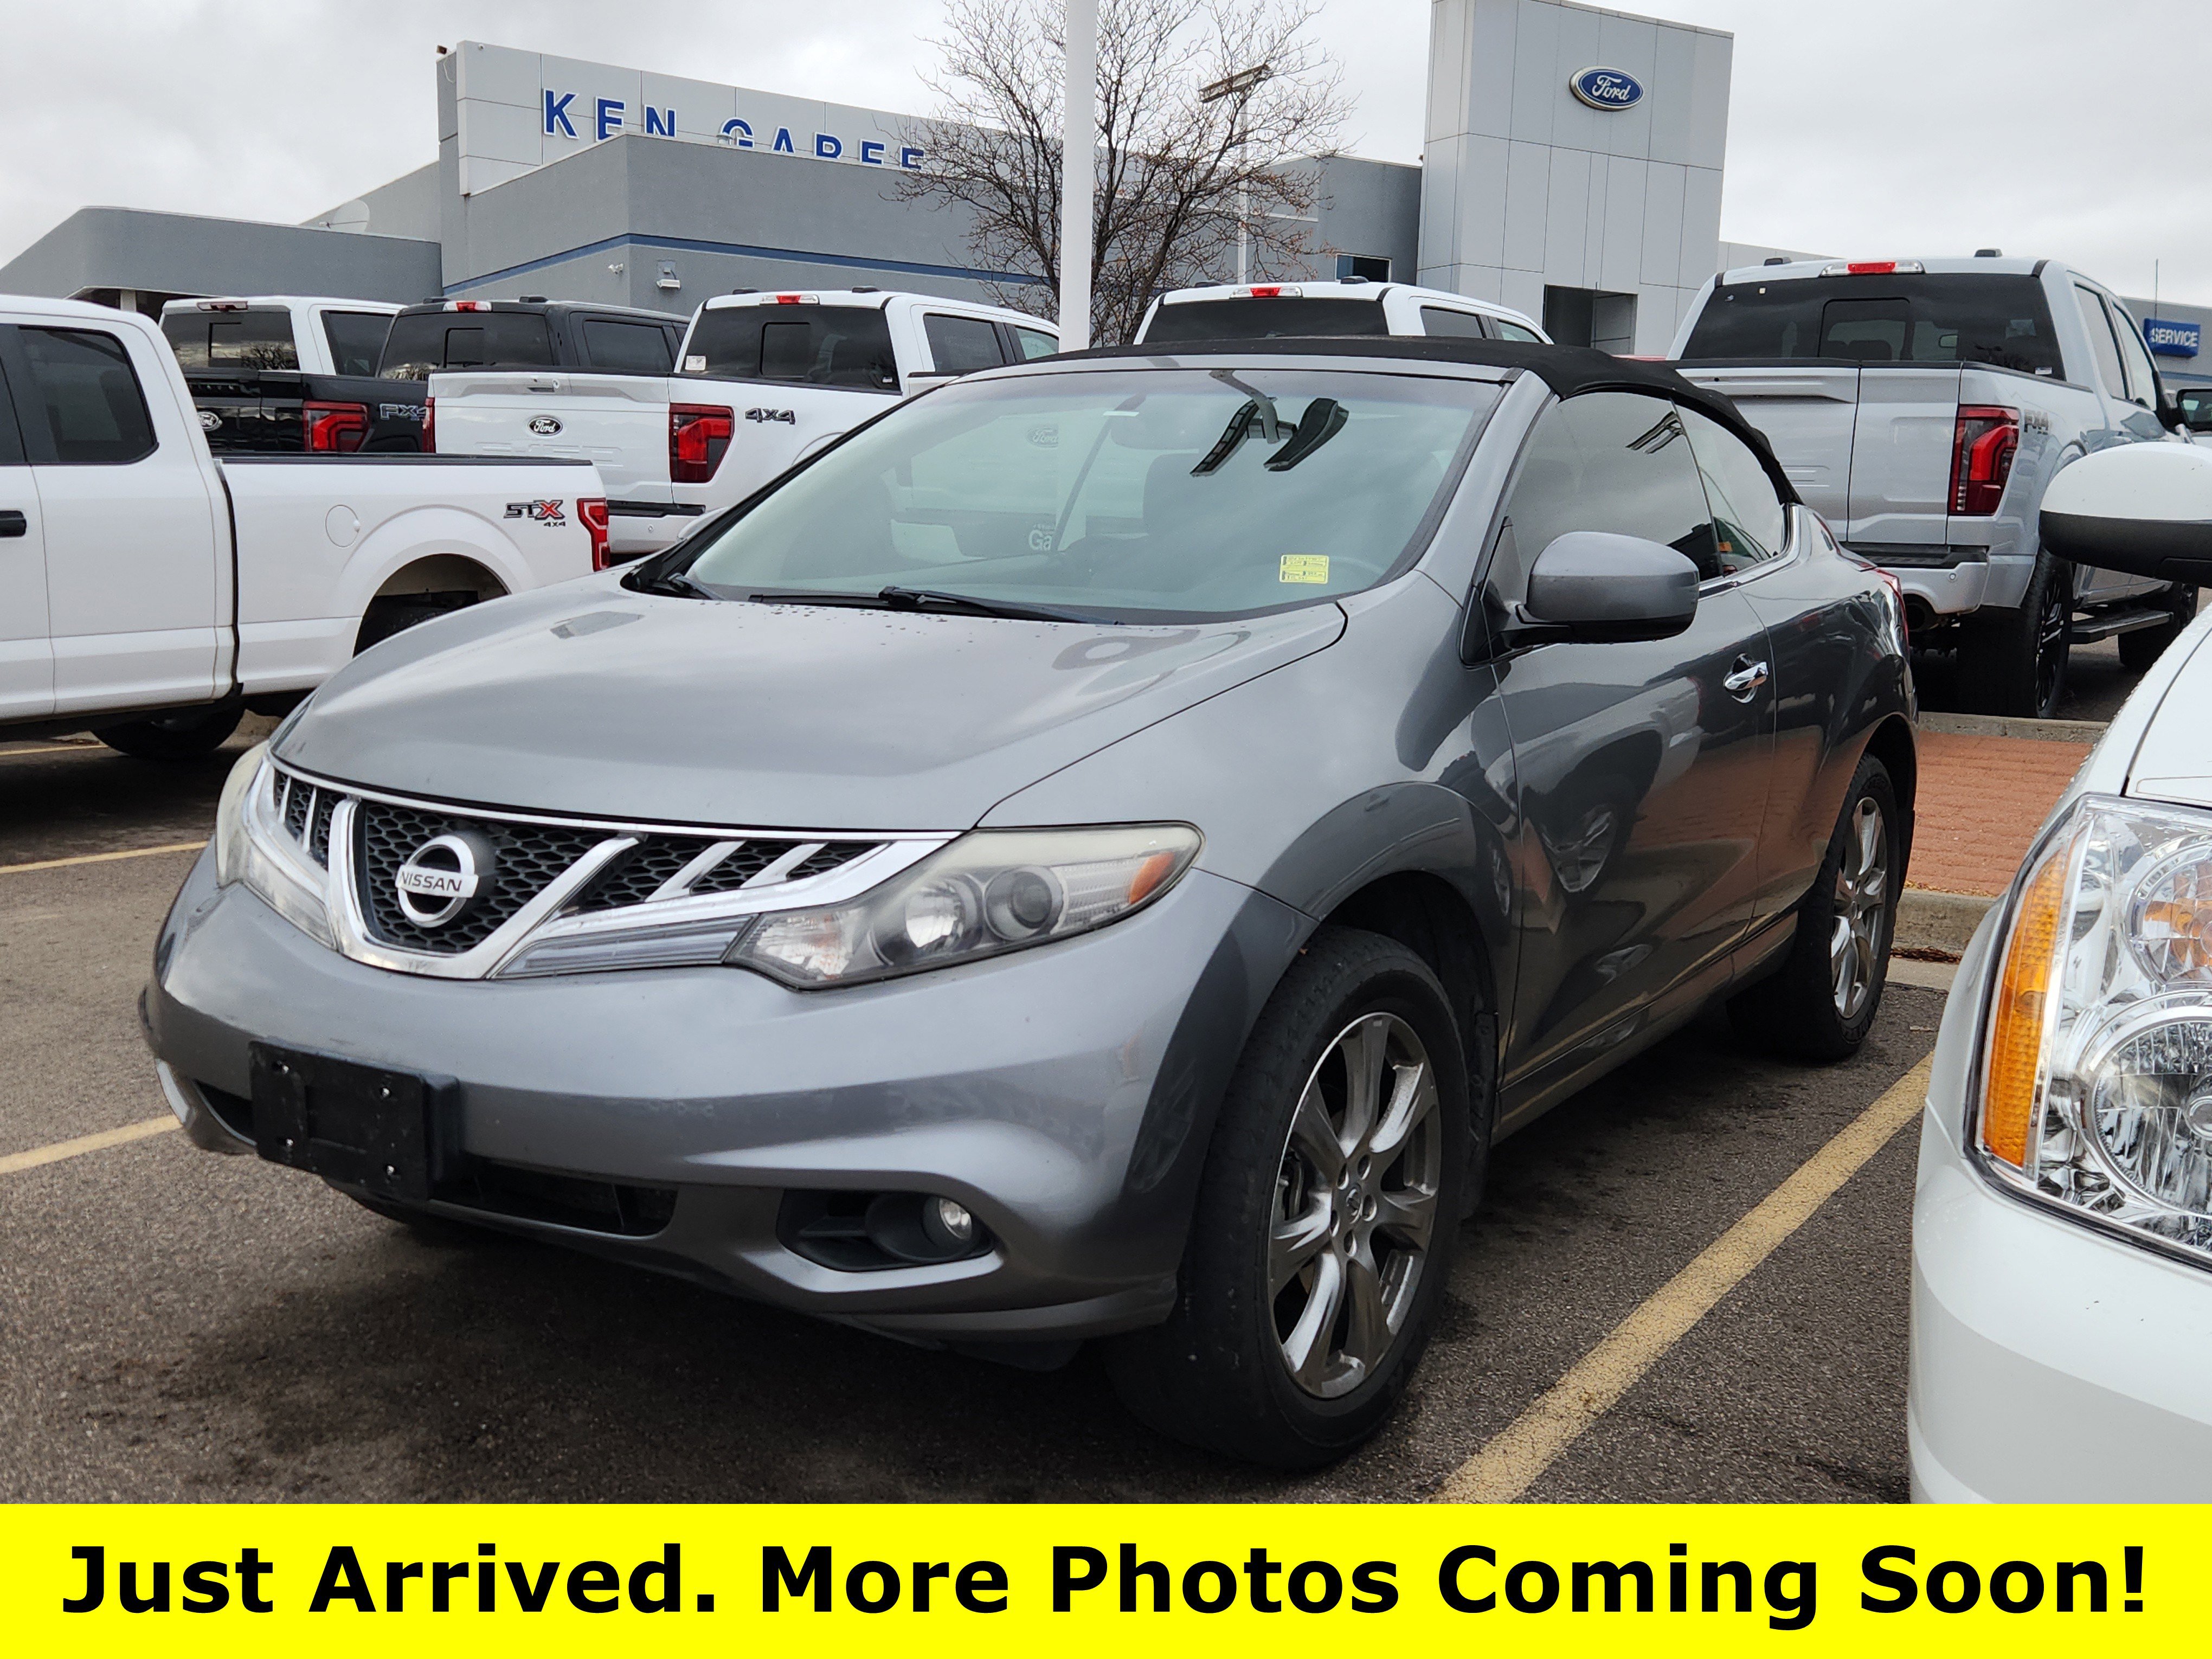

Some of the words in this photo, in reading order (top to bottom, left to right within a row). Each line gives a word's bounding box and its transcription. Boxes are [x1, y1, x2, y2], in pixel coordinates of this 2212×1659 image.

[1592, 75, 1632, 101] Ford
[543, 88, 677, 142] KEN
[2150, 327, 2198, 347] SERVICE
[533, 419, 556, 433] Ford
[504, 499, 565, 520] STX
[401, 871, 462, 893] NISSAN
